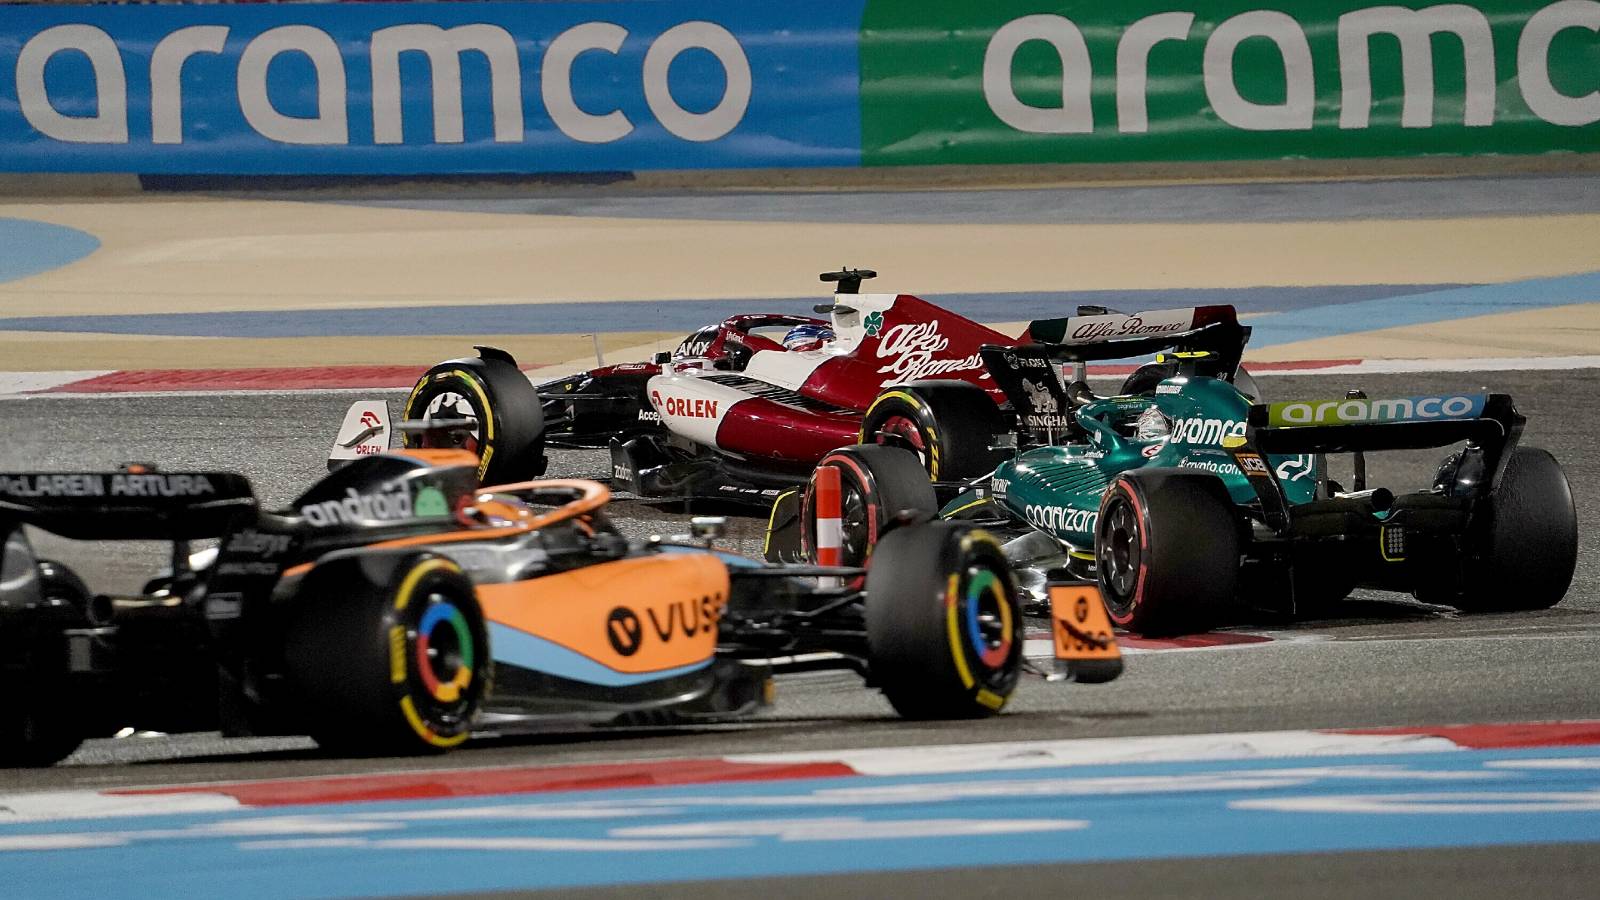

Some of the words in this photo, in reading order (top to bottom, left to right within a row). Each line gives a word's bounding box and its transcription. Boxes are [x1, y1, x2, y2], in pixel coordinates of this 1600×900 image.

[982, 0, 1600, 134] aramc
[15, 20, 752, 145] aramco
[876, 320, 949, 358] Alfa
[1072, 322, 1116, 342] Alfa
[1114, 317, 1185, 336] Romeo
[675, 342, 711, 357] AMX
[876, 350, 984, 388] Romeo
[666, 397, 719, 419] ORLEN
[1027, 415, 1068, 427] SINGHA
[1281, 396, 1473, 423] aramco
[356, 445, 382, 455] ORLEN
[1243, 457, 1267, 473] JCB
[112, 474, 215, 497] ARTURA
[301, 479, 411, 527] android
[1025, 503, 1099, 537] cognizan
